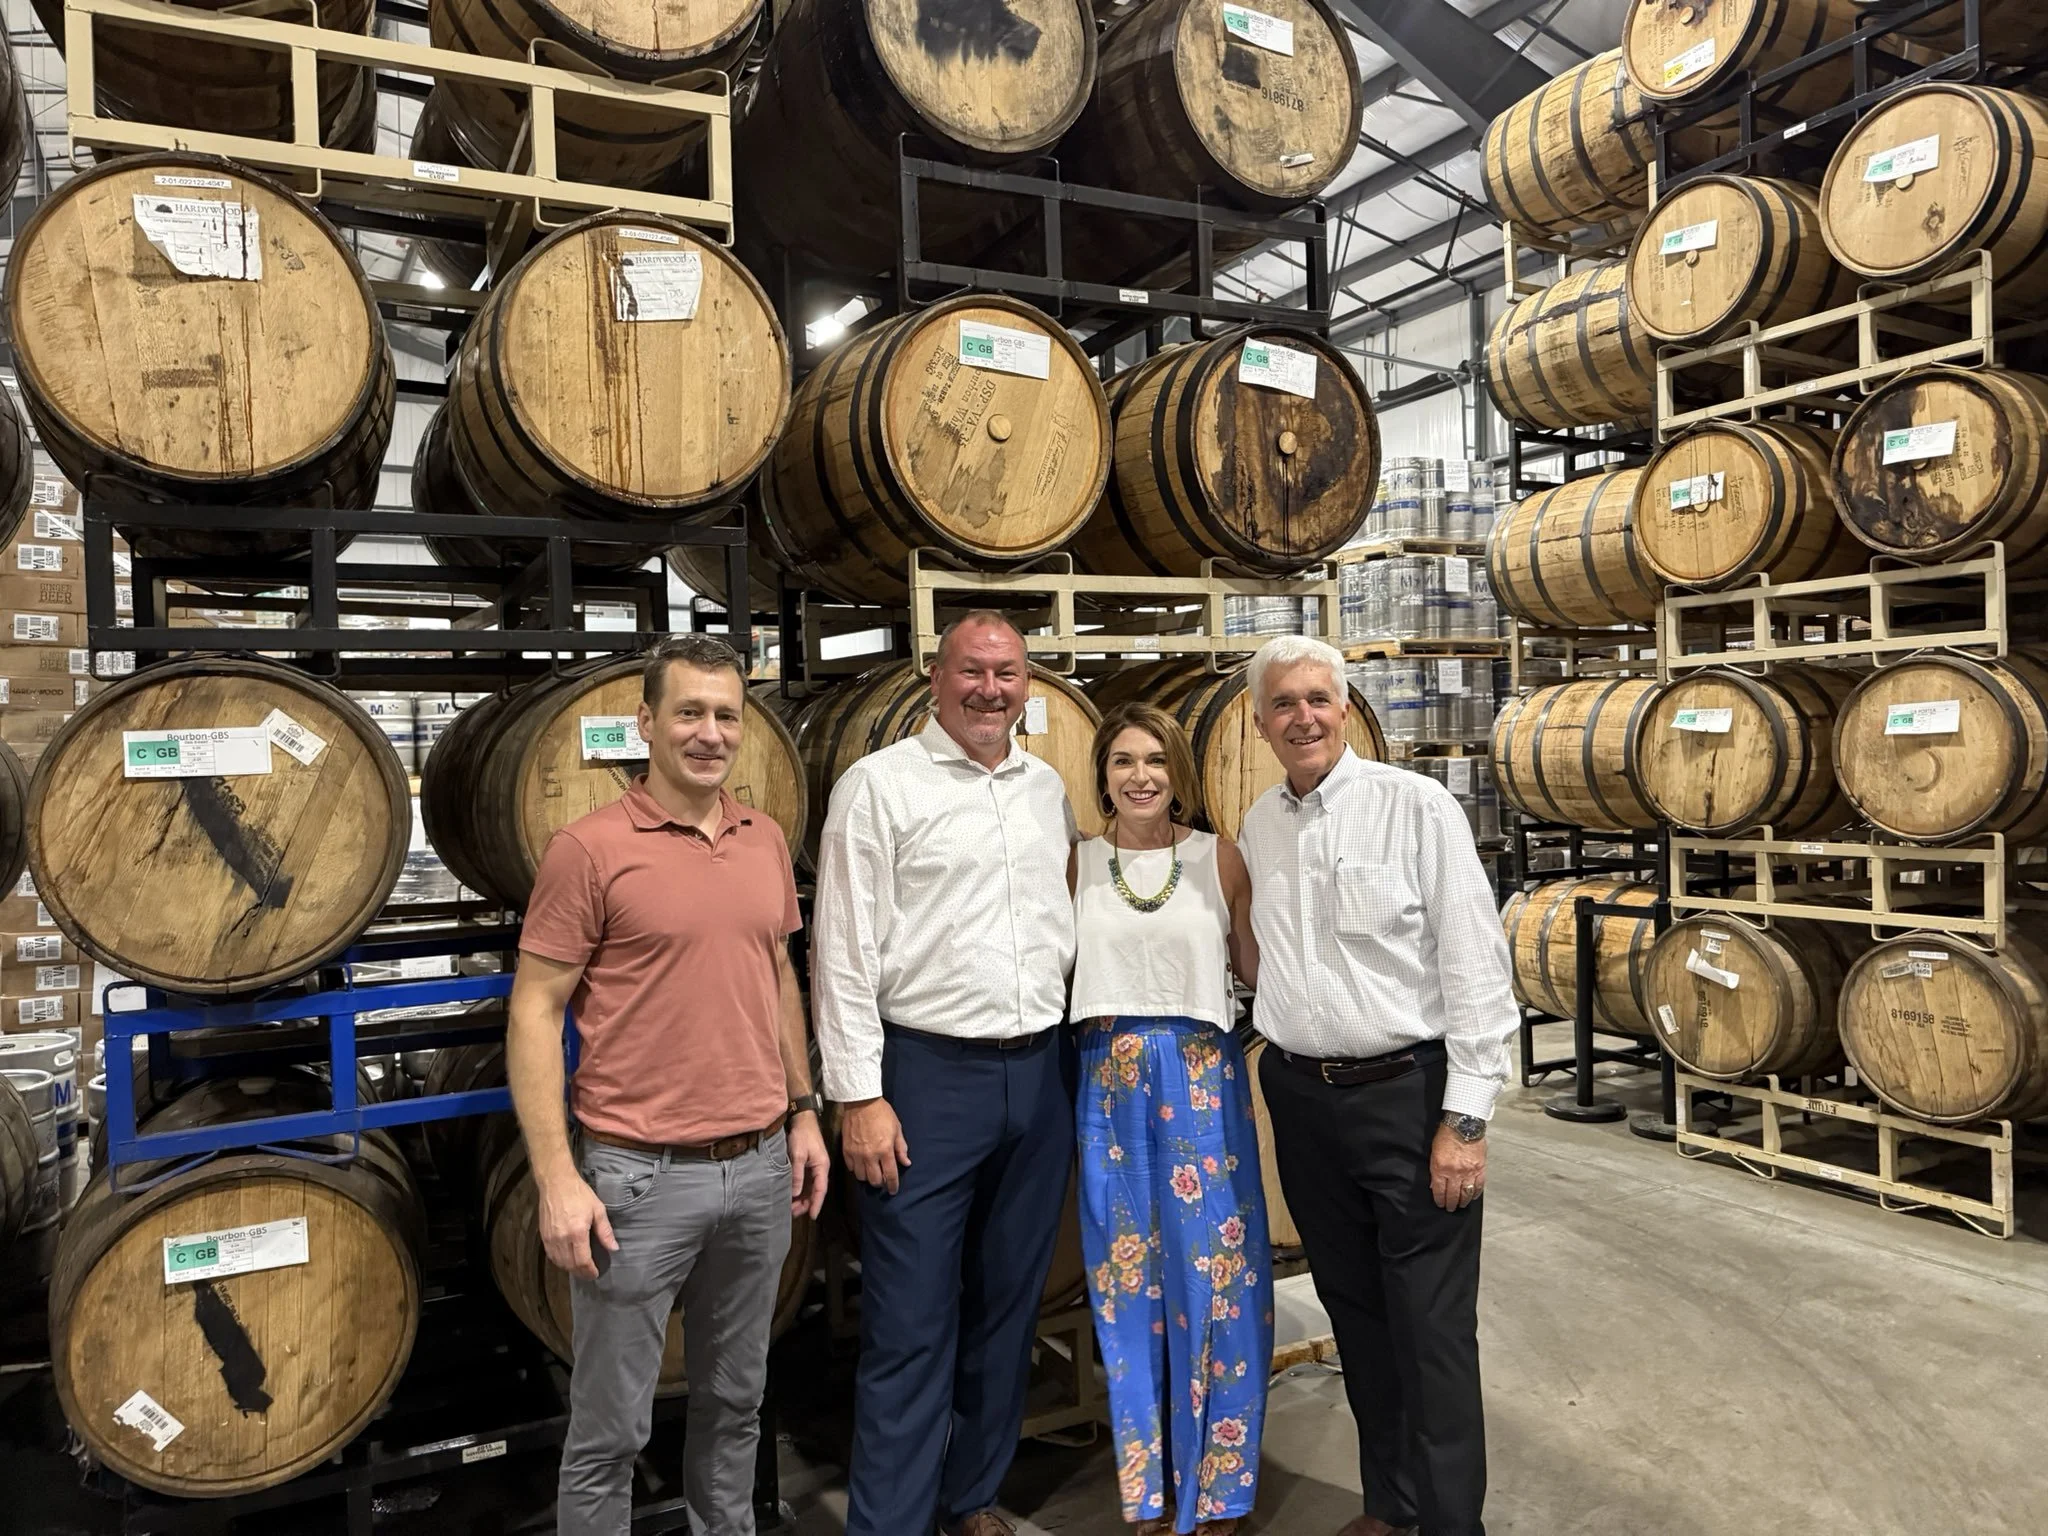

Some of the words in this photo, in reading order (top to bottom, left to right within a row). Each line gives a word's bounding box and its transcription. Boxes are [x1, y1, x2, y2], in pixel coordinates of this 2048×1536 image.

[1237, 19, 1248, 30] GB
[1261, 86, 1305, 112] 8719816
[1882, 163, 1892, 171] GB
[175, 203, 241, 216] HARDYWOOD
[635, 254, 686, 264] HARDYWOOD
[966, 342, 973, 351] C
[978, 343, 993, 354] GB
[1246, 352, 1252, 361] C
[1256, 354, 1269, 364] GB
[980, 379, 996, 404] DSP
[1899, 437, 1909, 446] GB
[34, 493, 46, 504] VA
[49, 527, 62, 538] VA
[33, 558, 45, 569] VA
[40, 590, 72, 605] BEER
[29, 628, 41, 639] VA
[167, 731, 229, 742] Bourbon-GBS
[591, 733, 599, 743] C
[607, 732, 624, 742] GB
[136, 748, 147, 759] C
[156, 747, 178, 759] GB
[35, 937, 47, 949] VA
[53, 965, 65, 977] VA
[35, 1010, 47, 1023] VA
[1891, 1008, 1935, 1024] 8169158
[55, 1080, 71, 1106] M
[206, 1226, 268, 1242] Bourbon-GBS
[176, 1252, 186, 1264] C
[195, 1247, 217, 1260] GB
